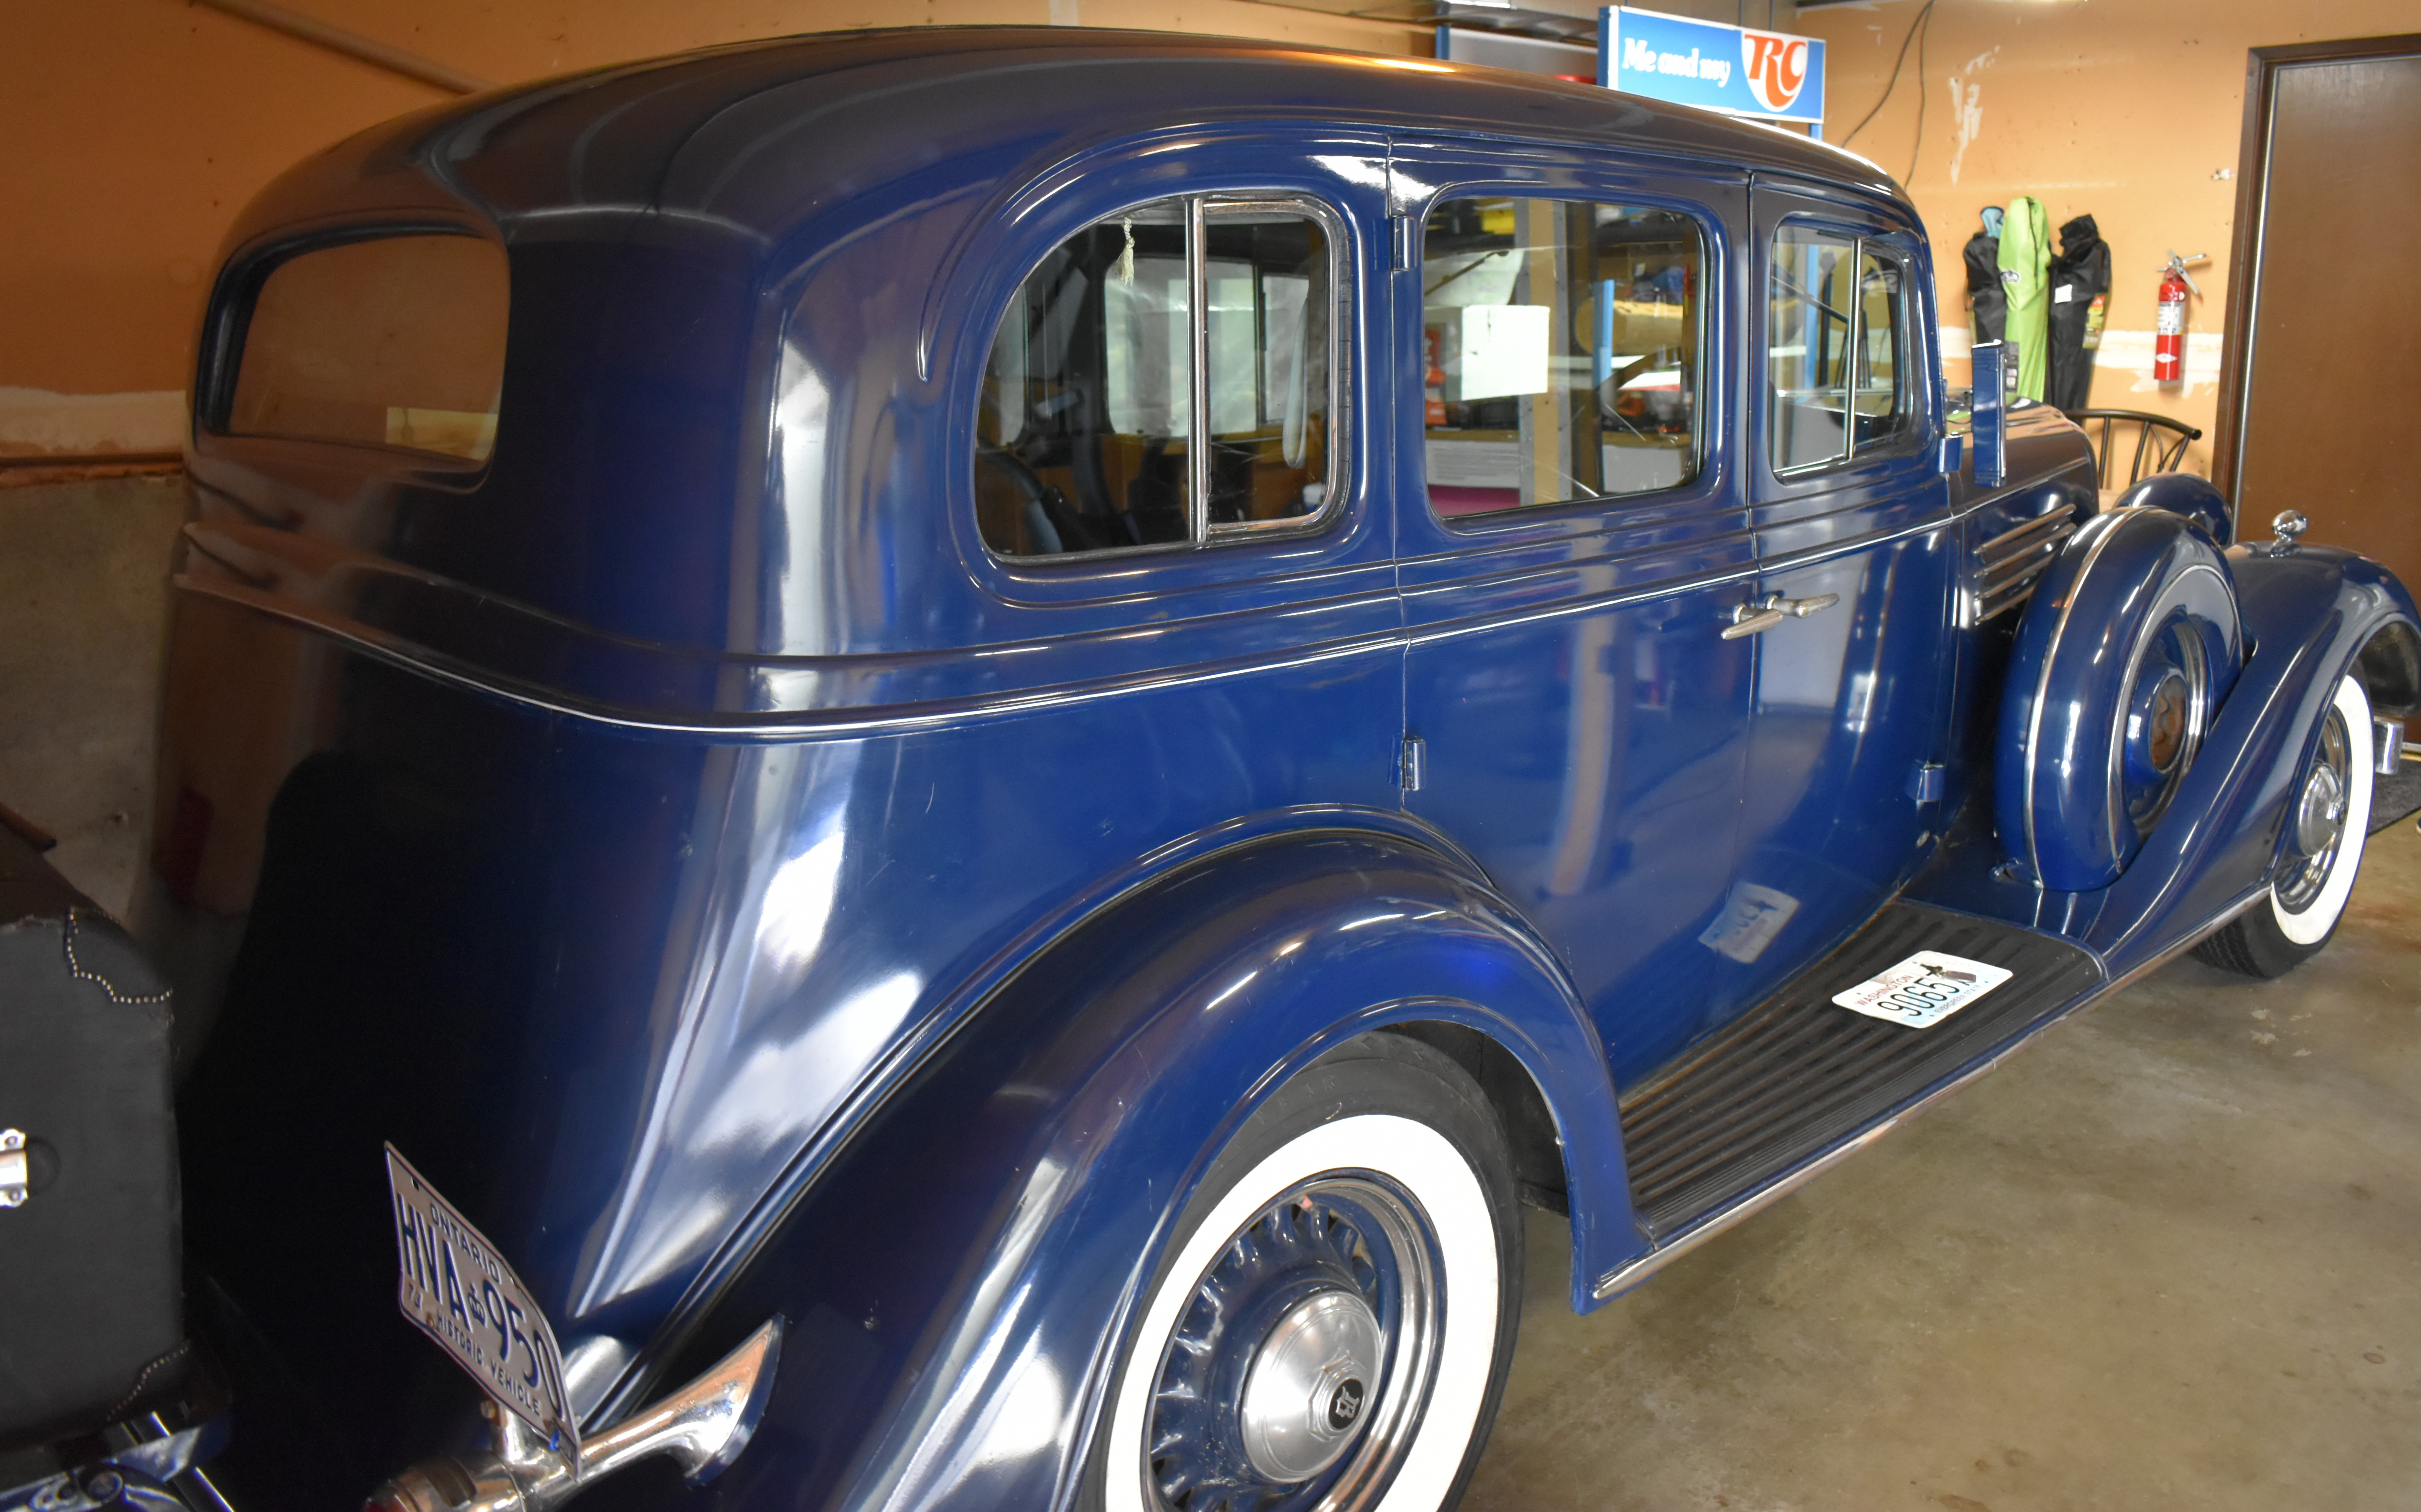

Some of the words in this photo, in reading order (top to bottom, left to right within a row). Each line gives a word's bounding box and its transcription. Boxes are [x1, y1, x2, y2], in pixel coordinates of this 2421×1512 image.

[1622, 38, 1656, 72] Me
[1658, 48, 1699, 77] and
[1699, 59, 1730, 88] my
[1745, 34, 1807, 107] RC
[1855, 974, 1914, 1006] WASHINGTON
[1877, 977, 1970, 1017] 9065
[1934, 994, 1966, 1013] EVERGREEN
[430, 1202, 502, 1285] ONTARIO
[397, 1193, 473, 1333] HVA
[483, 1279, 565, 1422] 950
[438, 1309, 484, 1368] HISTORIC
[491, 1358, 542, 1417] VEHICLE
